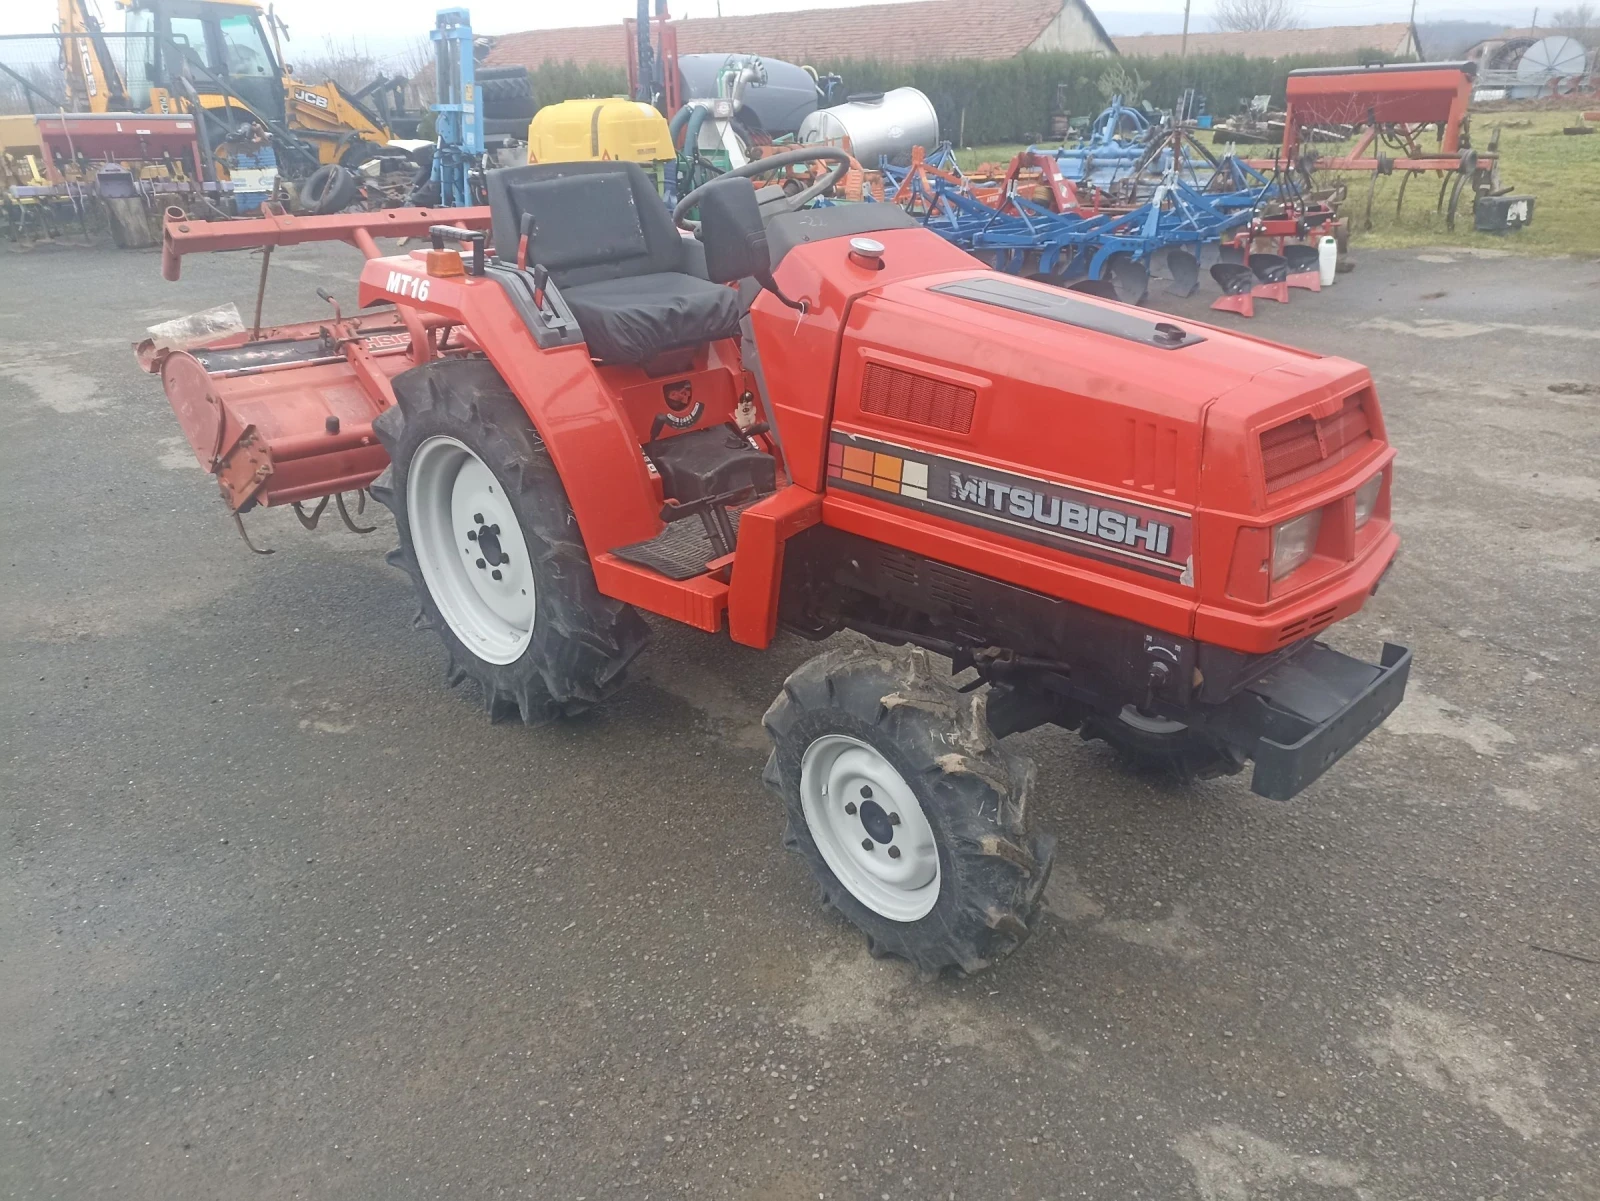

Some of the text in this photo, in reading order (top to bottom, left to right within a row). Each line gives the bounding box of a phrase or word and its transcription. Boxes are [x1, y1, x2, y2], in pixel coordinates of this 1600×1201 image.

[294, 88, 328, 109] JCB
[385, 270, 430, 302] MT16
[950, 471, 1171, 555] MITSUBISHI
